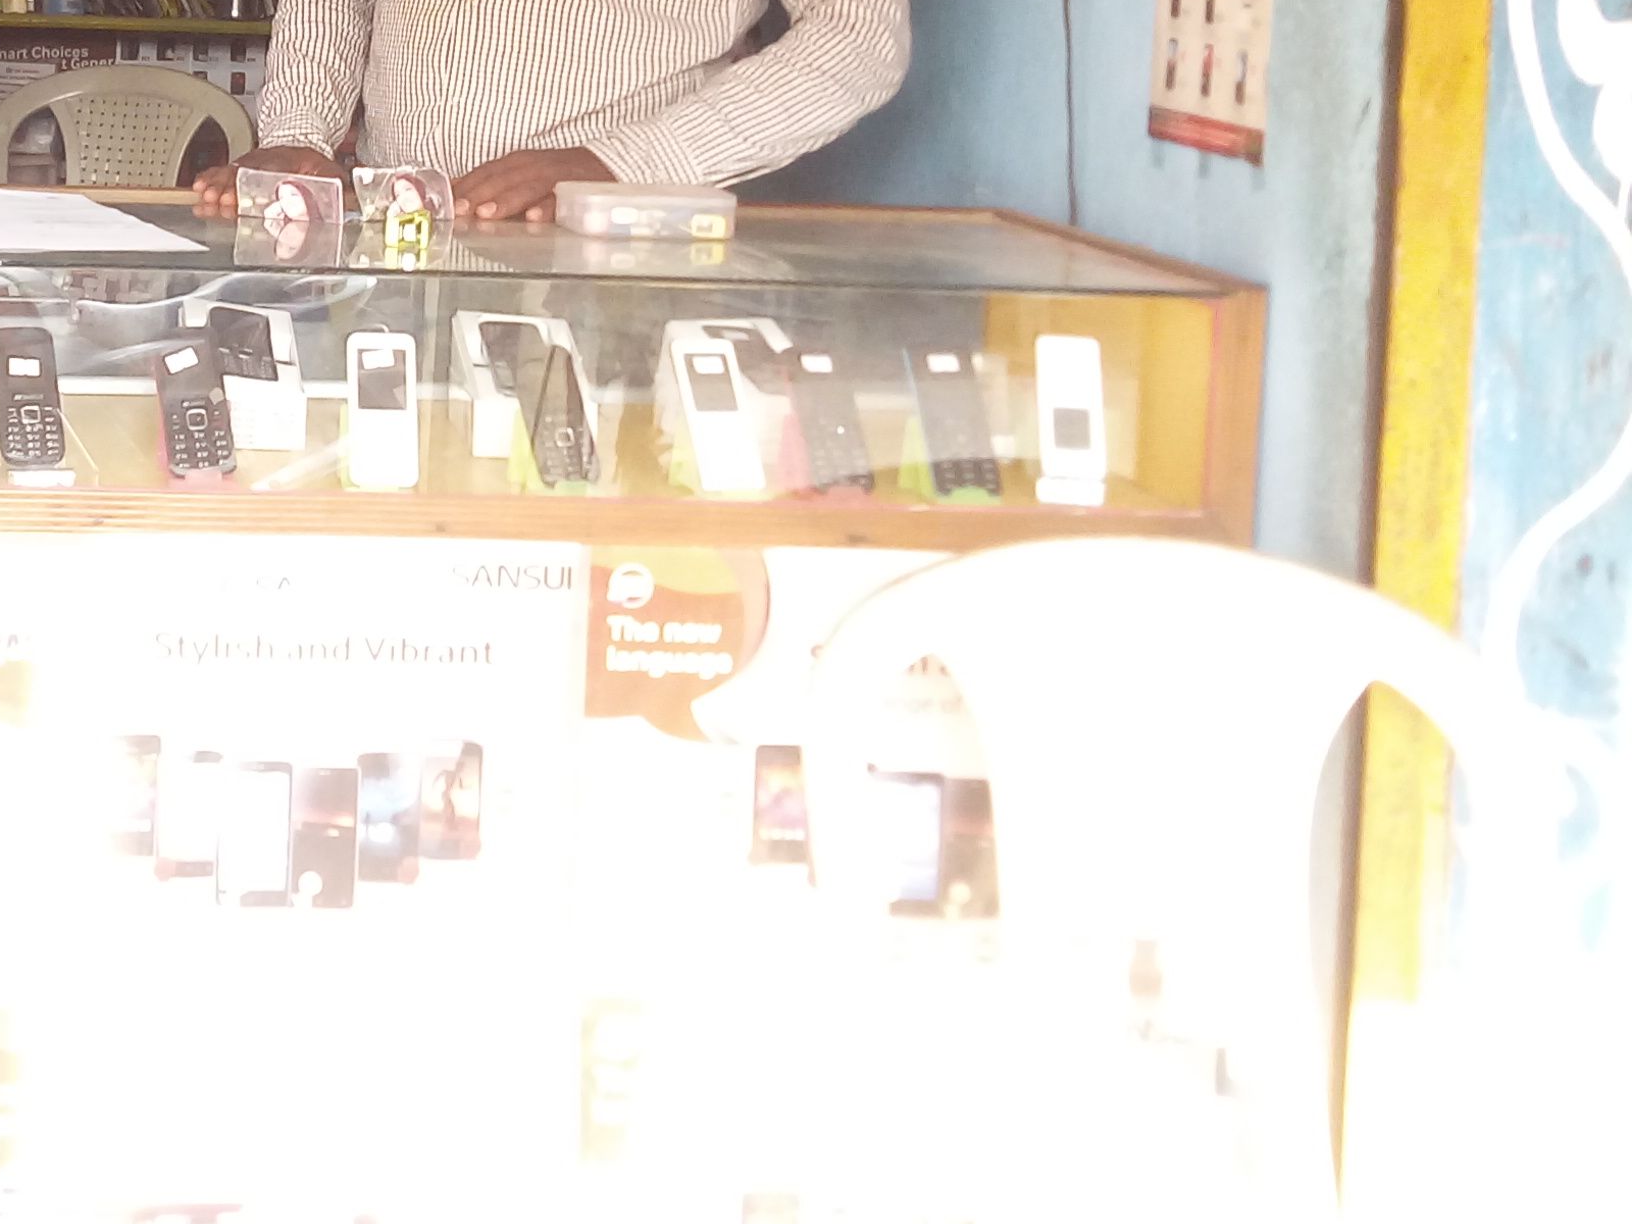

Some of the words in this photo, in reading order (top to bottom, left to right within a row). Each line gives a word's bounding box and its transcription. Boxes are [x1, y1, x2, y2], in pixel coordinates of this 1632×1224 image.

[31, 46, 89, 60] Choices
[450, 563, 573, 591] SANSUI
[606, 615, 661, 643] The
[154, 631, 274, 665] Stylish
[364, 637, 495, 665] Vibrant
